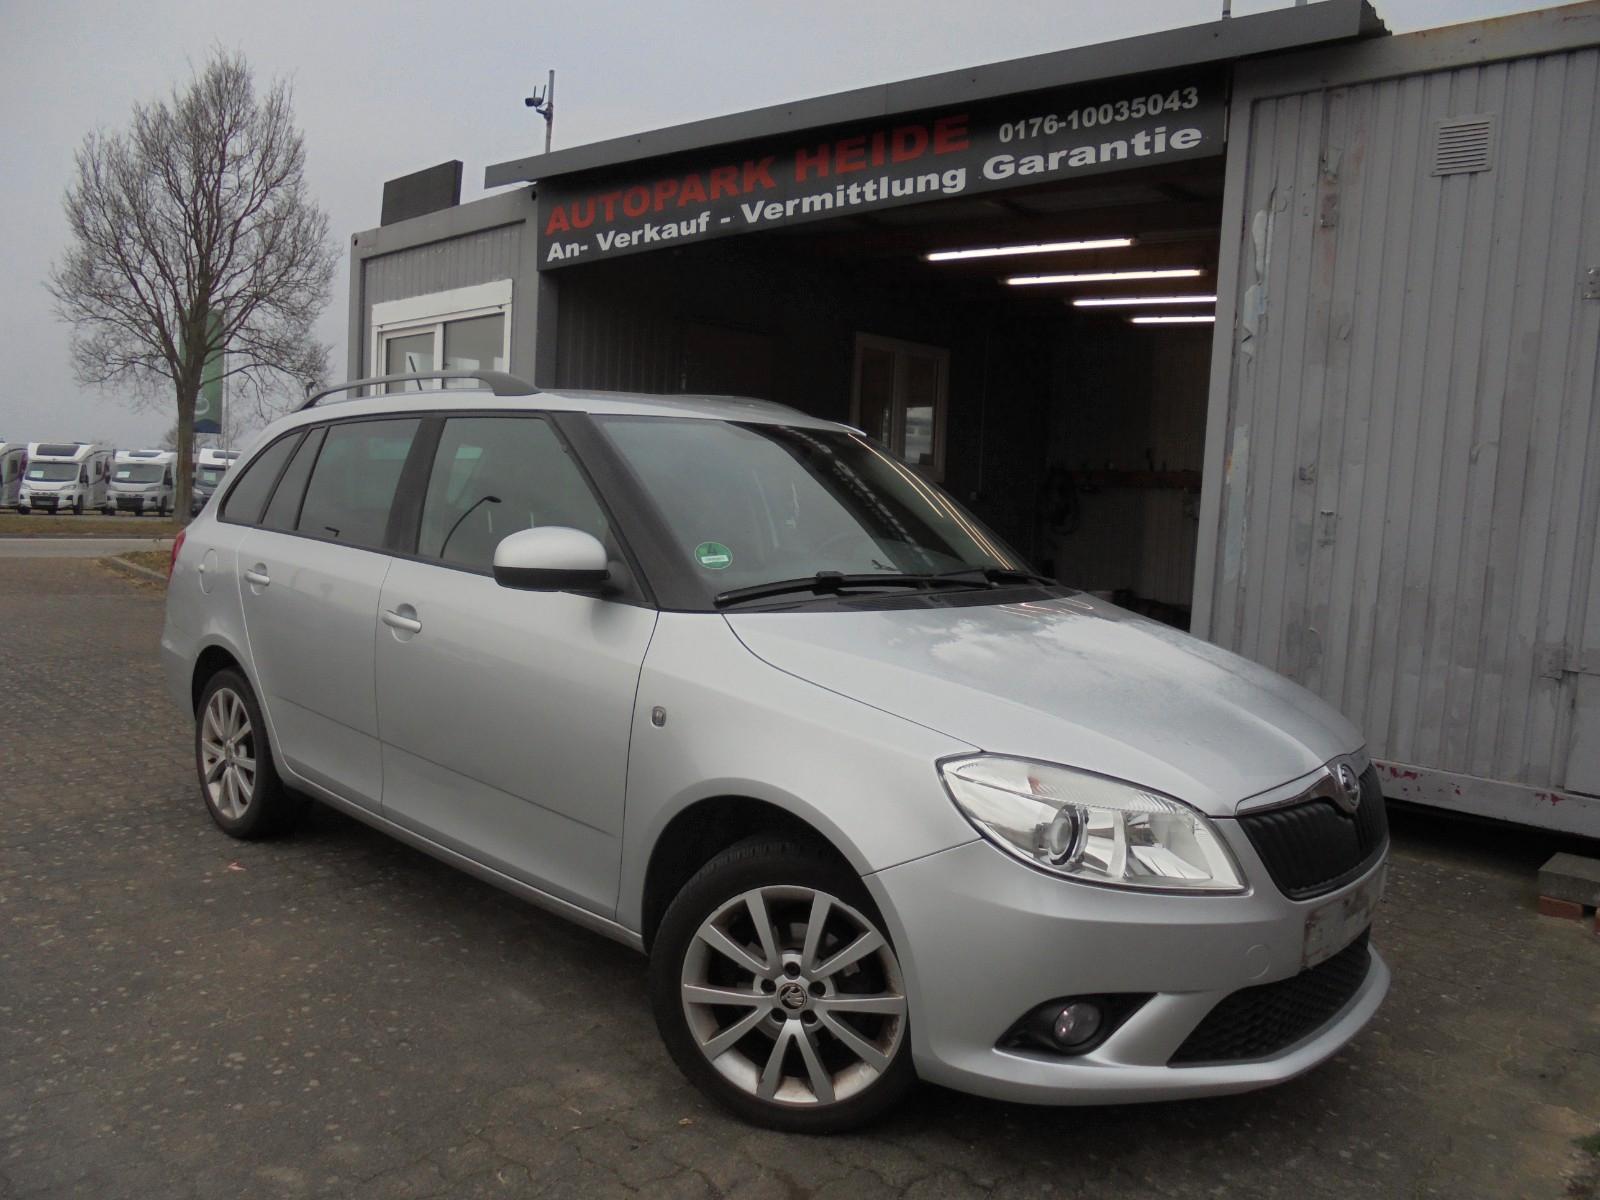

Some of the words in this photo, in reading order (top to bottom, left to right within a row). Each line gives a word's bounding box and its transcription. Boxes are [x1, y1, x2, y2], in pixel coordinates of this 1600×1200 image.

[545, 155, 777, 235] AUTOPARK
[794, 113, 972, 184] HEIDE
[999, 86, 1199, 143] 0176-10035043
[546, 241, 589, 262] An-
[596, 211, 711, 251] Verkauf
[740, 167, 966, 224] Vermittlung
[983, 126, 1203, 181] Garantie
